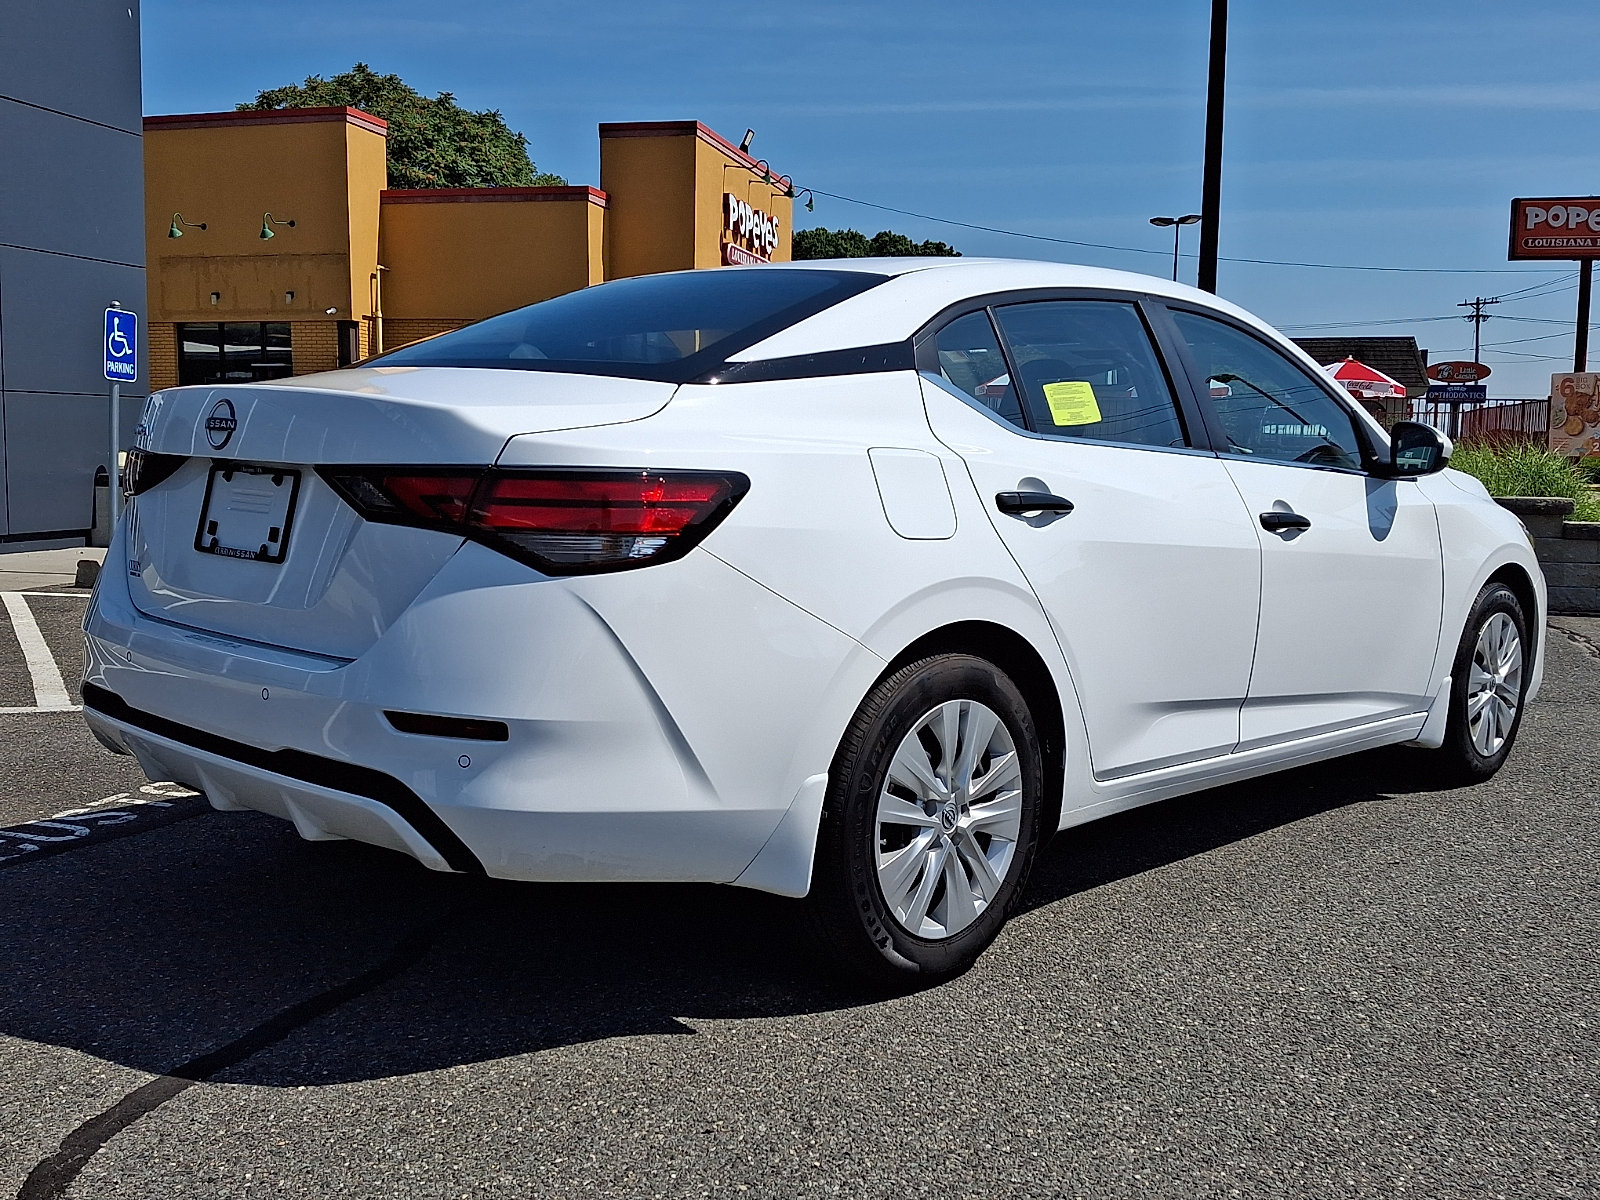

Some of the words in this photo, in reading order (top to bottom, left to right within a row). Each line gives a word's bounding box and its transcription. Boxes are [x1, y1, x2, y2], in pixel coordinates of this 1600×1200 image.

[1528, 238, 1592, 247] LOUISIANA
[107, 361, 134, 374] PARKING
[1428, 391, 1485, 399] OTHODONTICS
